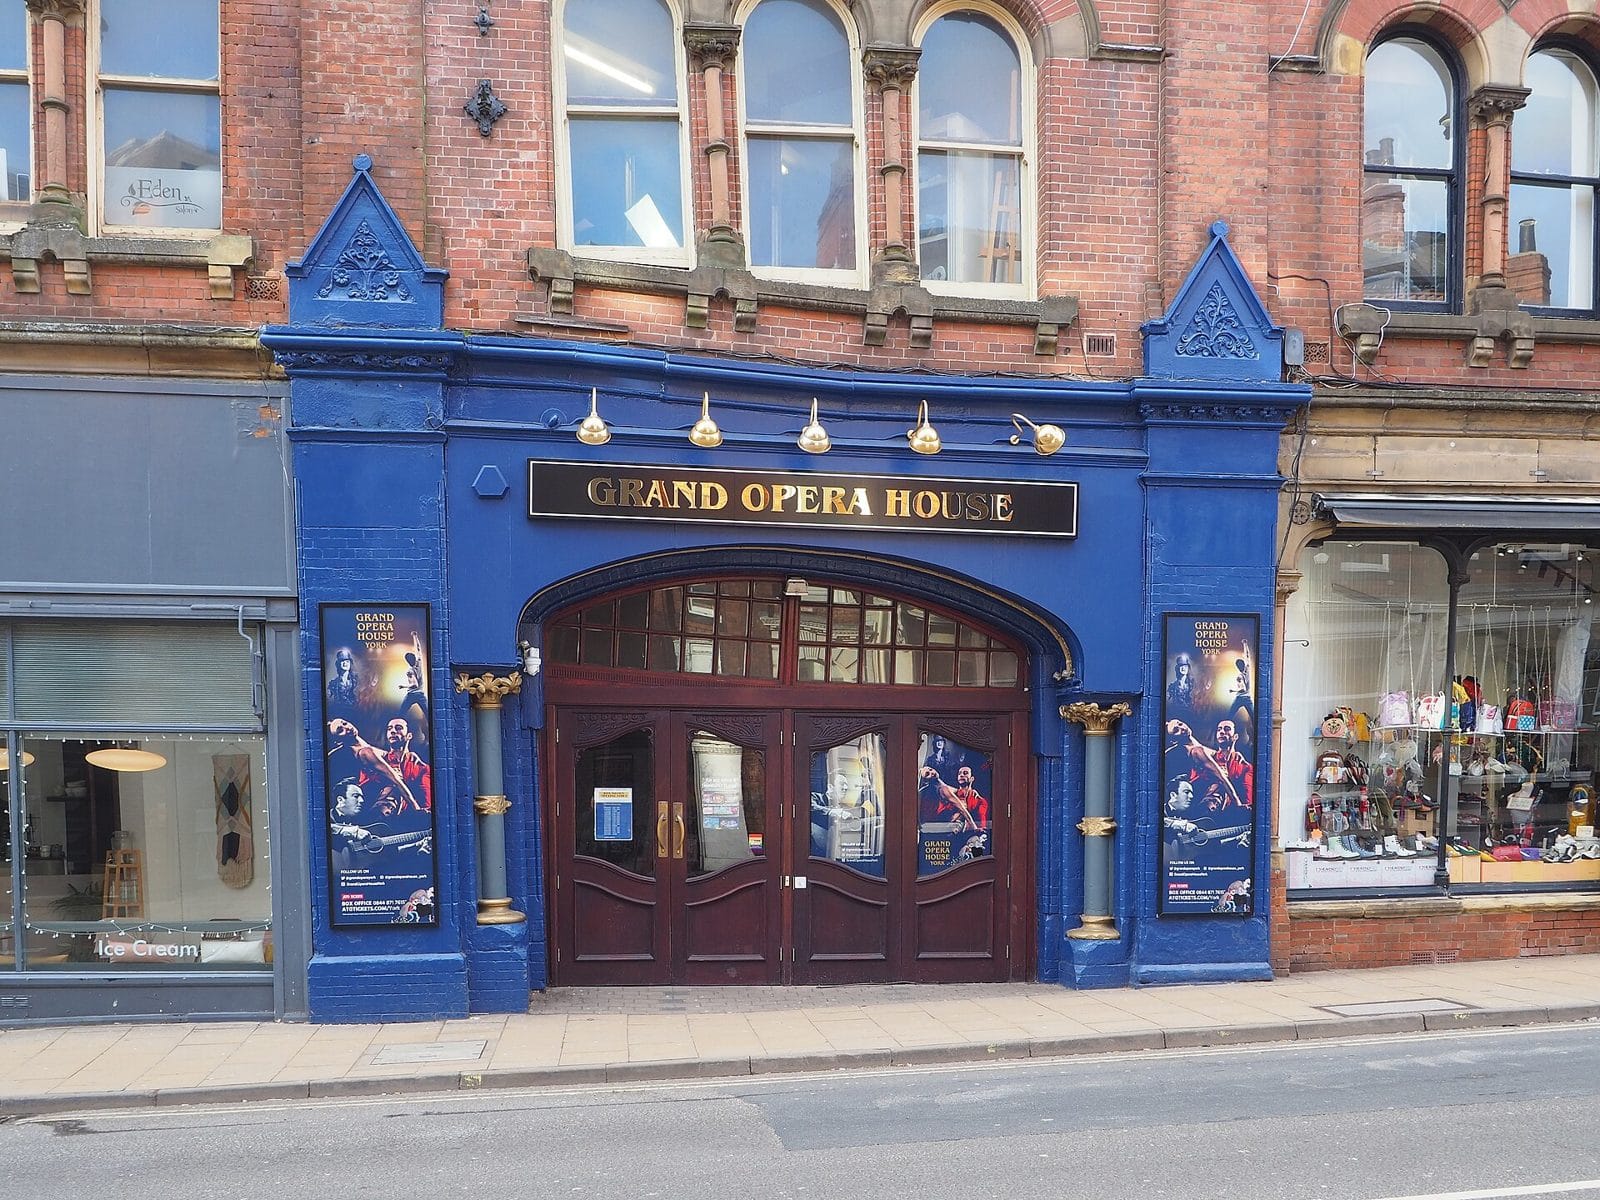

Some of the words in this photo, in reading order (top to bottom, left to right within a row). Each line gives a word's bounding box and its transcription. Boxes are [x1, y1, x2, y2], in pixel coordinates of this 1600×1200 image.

[137, 179, 181, 201] Eden
[587, 477, 729, 510] GRAND
[741, 483, 874, 516] OPERA
[884, 489, 1014, 522] HOUSE
[355, 613, 395, 621] GRAND
[357, 622, 394, 631] OPERA
[1194, 621, 1229, 630] GRAND
[357, 632, 395, 640] HOUSE
[1195, 630, 1228, 639] OPERA
[1195, 639, 1228, 648] HOUSE
[98, 940, 125, 956] Ice
[132, 939, 199, 957] Cream
